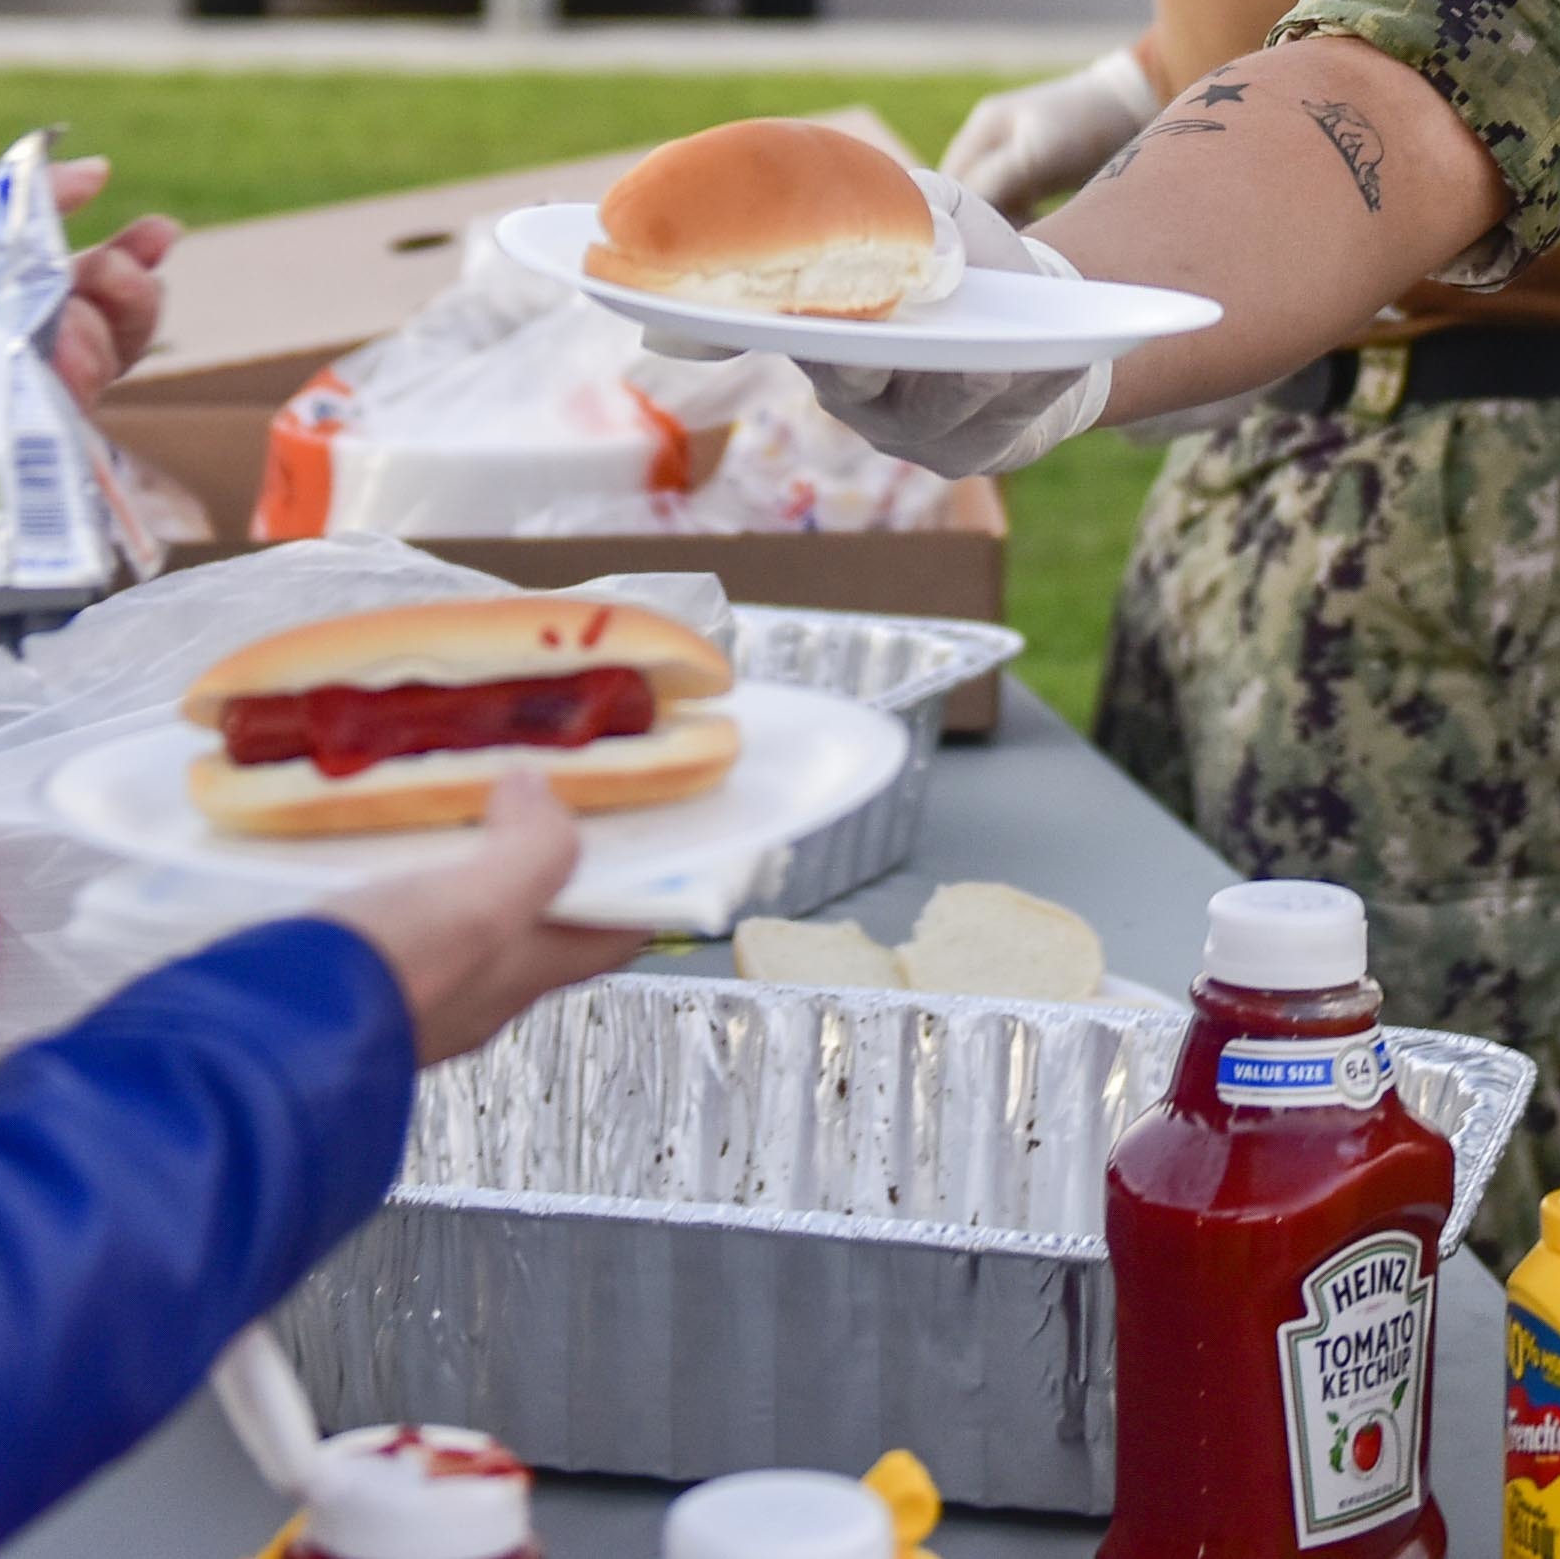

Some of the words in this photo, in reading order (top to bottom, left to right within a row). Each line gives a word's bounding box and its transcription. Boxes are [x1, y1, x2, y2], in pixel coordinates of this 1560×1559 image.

[1233, 1062, 1286, 1082] VALUE
[1287, 1063, 1326, 1082] SIZE
[1345, 1057, 1371, 1081] 64
[1331, 1257, 1407, 1315] HEINZ
[1314, 1309, 1415, 1374] TOMATO
[1321, 1346, 1412, 1403] KETCHUP
